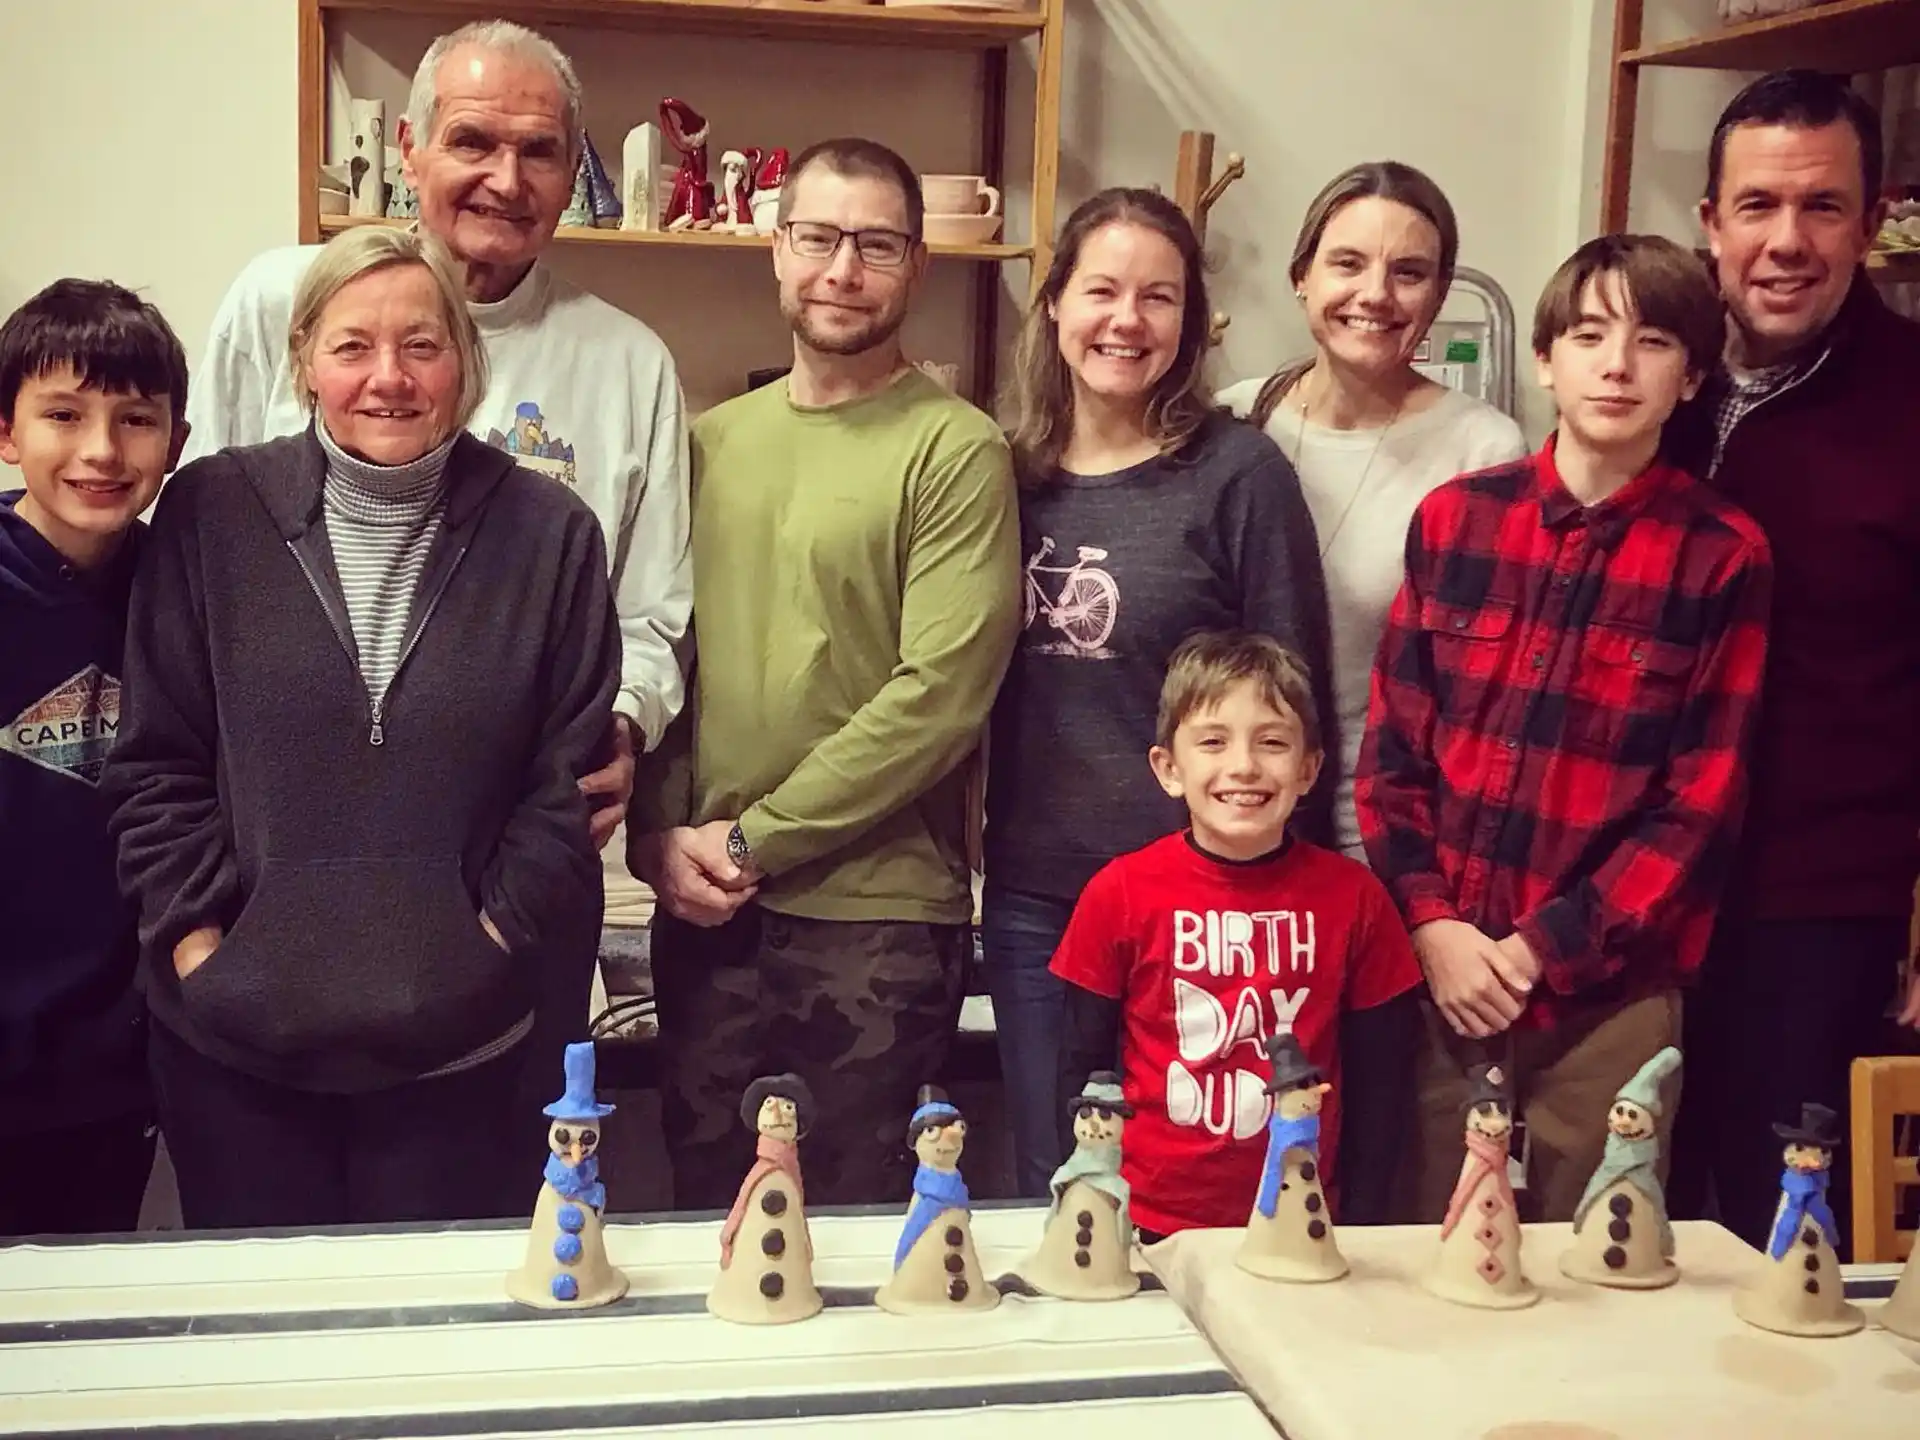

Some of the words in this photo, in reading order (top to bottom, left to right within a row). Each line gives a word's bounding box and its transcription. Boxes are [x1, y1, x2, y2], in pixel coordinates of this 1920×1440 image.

[1173, 910, 1316, 978] BIRTH
[1173, 977, 1311, 1062] DAY
[1166, 1060, 1279, 1140] DUD
